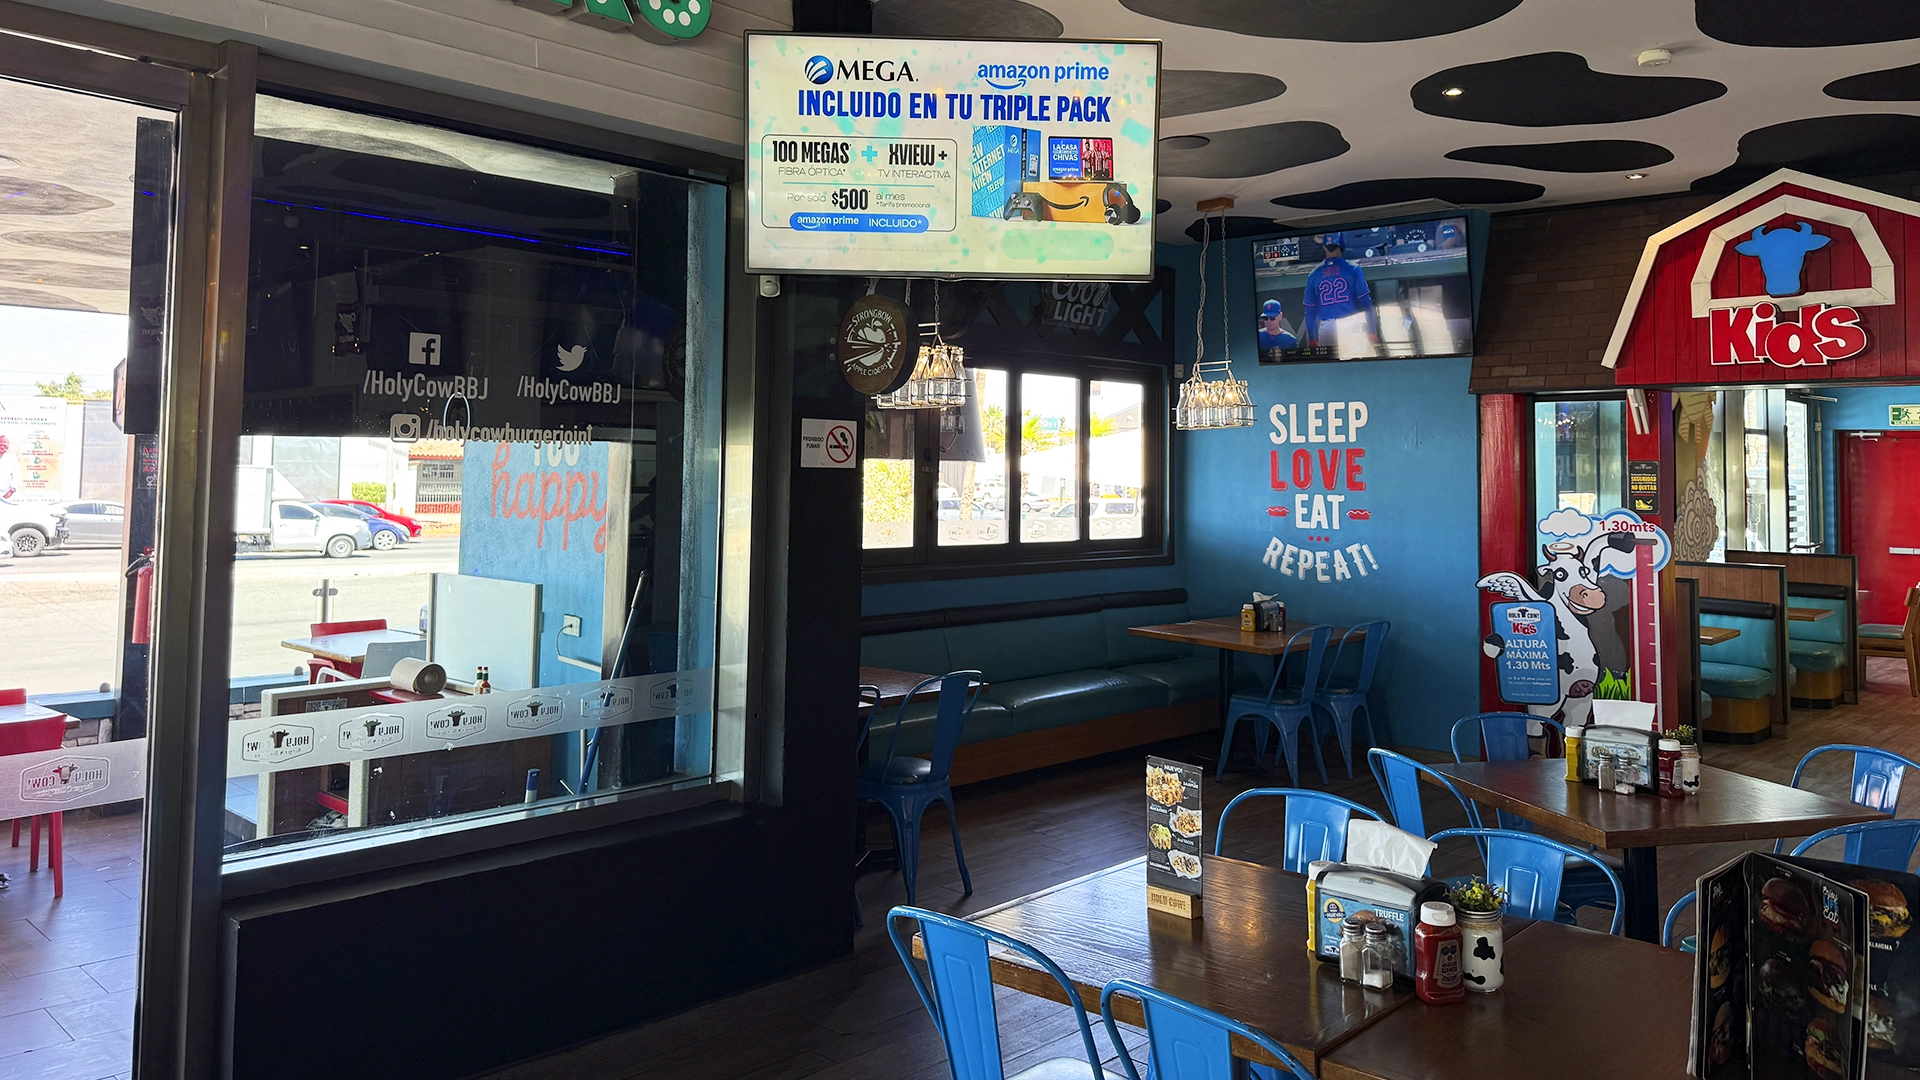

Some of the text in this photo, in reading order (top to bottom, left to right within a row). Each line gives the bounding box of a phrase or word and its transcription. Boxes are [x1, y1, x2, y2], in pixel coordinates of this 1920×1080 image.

[978, 62, 1109, 83] amazon prime
[798, 89, 1111, 122] INCLUIDO EN TU TRIPLE PACK
[772, 141, 798, 163] 100
[889, 143, 935, 166] XVIEW
[778, 166, 805, 176] FIBRA
[878, 168, 951, 180] TV INTERACTIVA
[787, 192, 827, 203] Por sólo
[876, 193, 906, 201] al mes
[797, 215, 859, 226] amazon prime
[1319, 277, 1349, 305] 22
[852, 309, 893, 327] STRONGBOW
[1053, 301, 1108, 327] LIGHT
[1709, 301, 1867, 368] Kids
[851, 362, 867, 376] APPLE
[363, 370, 489, 402] /HolyCowBBJ
[517, 375, 622, 405] /HolyCowBBJ
[1269, 401, 1369, 445] SLEEP
[426, 418, 593, 450] /holycowburgerjoint
[1270, 448, 1367, 491] LOVE
[490, 440, 608, 554] happy
[1295, 493, 1345, 529] EAT
[1599, 520, 1656, 533] 1.30mts
[1262, 536, 1379, 583] REPEAT!
[1512, 622, 1538, 635] Kids
[1505, 639, 1548, 649] ALTURA
[1506, 649, 1549, 660] MÁXIMA
[1506, 661, 1551, 670] 1.30 Mts
[1151, 892, 1168, 906] HOLY
[1374, 908, 1405, 922] TRUFFLE
[1823, 905, 1840, 924] Eat
